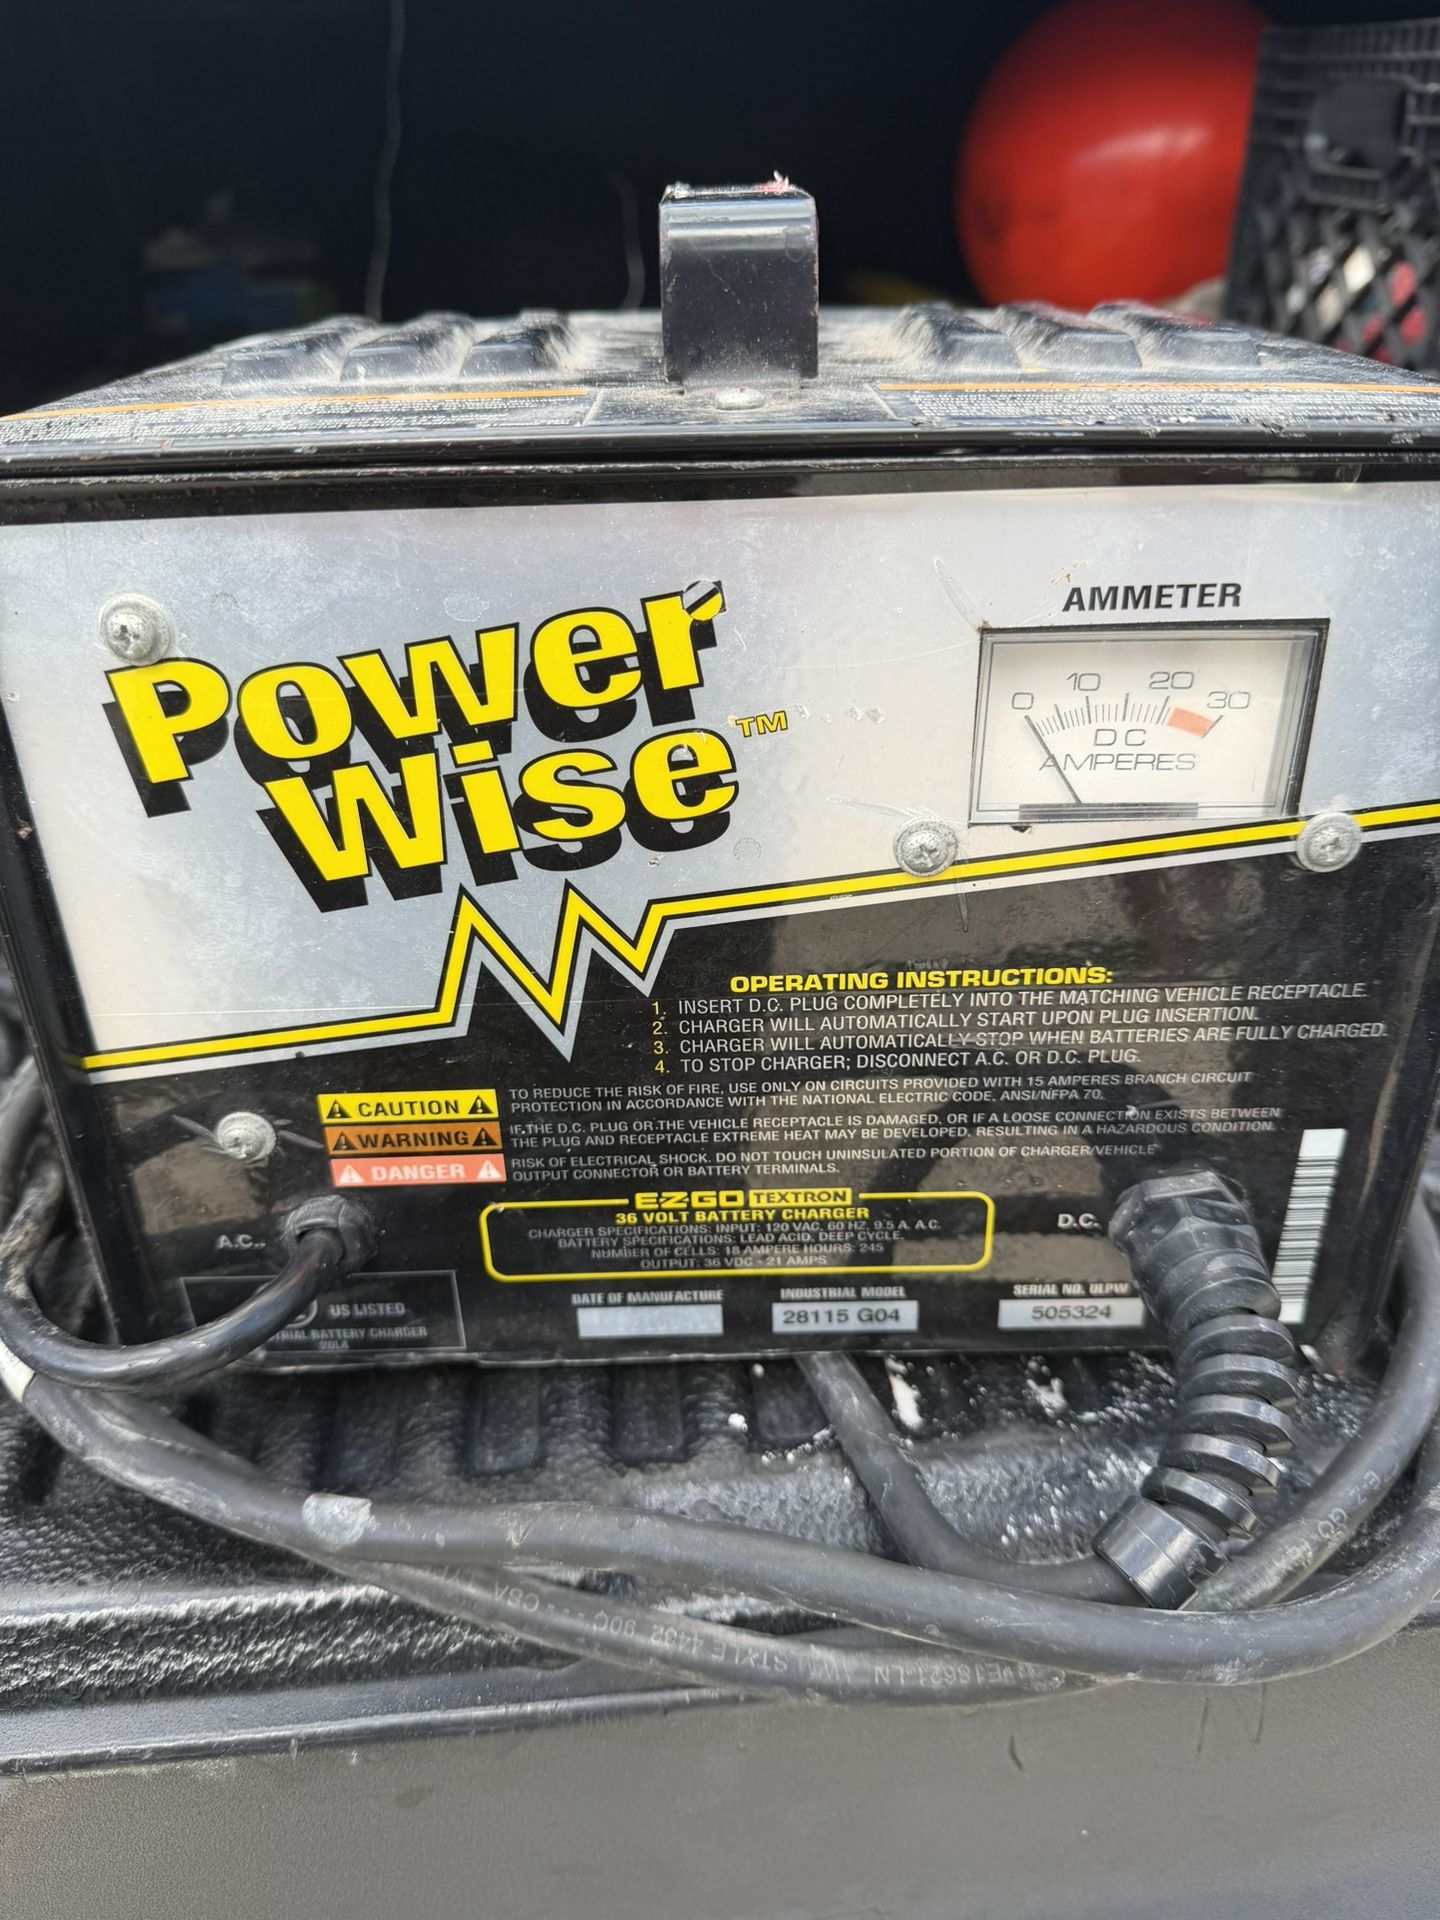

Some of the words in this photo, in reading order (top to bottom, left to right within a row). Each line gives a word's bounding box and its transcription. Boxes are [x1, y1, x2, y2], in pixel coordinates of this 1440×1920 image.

[1062, 582, 1242, 612] AMMETER
[1066, 672, 1101, 691] 10
[1149, 671, 1195, 690] 20
[102, 581, 726, 814] Power
[1011, 692, 1035, 710] 0
[1206, 691, 1252, 709] 30
[735, 711, 788, 738] TM
[1039, 753, 1198, 771] AMPERES
[255, 728, 739, 908] Wise
[730, 972, 888, 993] OPERATING
[897, 967, 1113, 988] INSTRUCTIONS:
[652, 1001, 667, 1015] 1.
[678, 999, 743, 1015] INSERT
[749, 998, 783, 1012] D.C.
[790, 996, 838, 1011] PLUG
[844, 993, 965, 1010] COMPLETELY
[970, 991, 1013, 1007] INTO
[1019, 990, 1054, 1006] THE
[1060, 988, 1159, 1004] MATCHING
[1165, 986, 1243, 1002] VEHICLE
[1247, 983, 1368, 1000] RECEPTACLE.
[652, 1021, 667, 1036] 2.
[678, 1018, 764, 1034] CHARGER
[770, 1017, 815, 1031] WILL
[820, 1013, 972, 1030] AUTOMATICALLY
[977, 1011, 1037, 1027] START
[1042, 1010, 1093, 1025] UPON
[1099, 1009, 1149, 1024] PLUG
[1155, 1006, 1259, 1022] INSERTION.
[653, 1040, 669, 1055] 3.
[680, 1038, 764, 1054] CHARGER
[770, 1036, 815, 1051] WILL
[820, 1033, 972, 1050] AUTOMATICALLY
[976, 1031, 1024, 1046] STOP
[1029, 1030, 1083, 1045] WHEN
[1090, 1028, 1188, 1044] BATTERIES
[1193, 1027, 1233, 1042] ARE
[1235, 1025, 1293, 1041] FULLY
[1297, 1022, 1388, 1039] CHARGED.
[654, 1059, 670, 1074] 4.
[680, 1059, 704, 1073] TO
[709, 1057, 755, 1072] STOP
[761, 1055, 851, 1071] CHARGER;
[856, 1052, 971, 1068] DISCONNECT
[975, 1051, 1009, 1066] A.C.
[1015, 1051, 1041, 1065] OR
[1047, 1049, 1081, 1064] D.C.
[1088, 1048, 1141, 1064] PLUG.
[533, 1087, 591, 1099] REDUCE
[595, 1086, 623, 1097] THE
[627, 1085, 662, 1096] RISK
[729, 1083, 757, 1094] USE
[761, 1081, 800, 1093] ONLY
[830, 1079, 898, 1091] CIRCUITS
[904, 1077, 978, 1089] PROVIDED
[983, 1076, 1021, 1087] WITH
[1047, 1074, 1120, 1086] AMPERES
[1124, 1073, 1186, 1084] BRANCH
[1191, 1071, 1252, 1083] CIRCUIT
[357, 1099, 460, 1118] CAUTION
[511, 1101, 602, 1113] PROTECTION
[626, 1097, 724, 1110] ACCORDANCE
[728, 1095, 766, 1107] WITH
[770, 1094, 798, 1106] THE
[802, 1093, 875, 1105] NATIONAL
[879, 1091, 948, 1103] ELECTRIC
[1000, 1089, 1079, 1101] ANSI/NFPA
[526, 1124, 553, 1134] THE
[557, 1123, 586, 1134] D.C.
[590, 1122, 628, 1133] PLUG
[658, 1120, 685, 1131] THE
[689, 1118, 748, 1130] VEHICLE
[753, 1116, 843, 1128] RECEPTACLE
[1003, 1111, 1051, 1123] LOOSE
[1055, 1109, 1150, 1122] CONNECTION
[1155, 1108, 1206, 1120] EXISTS
[1210, 1107, 1280, 1119] BETWEEN
[356, 1130, 469, 1149] WARNING
[510, 1137, 538, 1148] THE
[542, 1136, 581, 1147] PLUG
[585, 1135, 615, 1146] AND
[620, 1132, 709, 1145] RECEPTACLE
[714, 1131, 779, 1142] EXTREME
[784, 1130, 820, 1140] HEAT
[825, 1129, 857, 1140] MAY
[976, 1125, 1058, 1136] RESULTING
[1082, 1124, 1092, 1135] A
[1096, 1122, 1187, 1135] HAZARDOUS
[1191, 1121, 1275, 1133] CONDITION.
[511, 1157, 545, 1169] RISK
[549, 1157, 567, 1168] OF
[571, 1154, 656, 1167] ELECTRICAL
[659, 1153, 711, 1165] SHOCK.
[716, 1152, 736, 1163] DO
[740, 1151, 770, 1162] NOT
[774, 1150, 822, 1161] TOUCH
[826, 1148, 926, 1160] UNINSULATED
[930, 1147, 994, 1159] PORTION
[999, 1146, 1018, 1157] OF
[1021, 1144, 1156, 1157] CHARGER/VEHICLE
[370, 1163, 465, 1182] DANGER
[513, 1169, 569, 1182] OUTPUT
[573, 1167, 659, 1180] CONNECTOR
[663, 1166, 683, 1177] OR
[688, 1164, 750, 1176] BATTERY
[755, 1162, 840, 1175] TERMINALS.
[635, 1190, 744, 1210] EZGO
[753, 1190, 848, 1204] TEXTRON
[616, 1213, 637, 1224] 36
[642, 1211, 690, 1224] VOLT
[695, 1209, 777, 1223] BATTERY
[781, 1207, 870, 1221] CHARGER
[1057, 1213, 1099, 1228] D.C.
[528, 1228, 594, 1240] CHARGER
[598, 1224, 711, 1237] SPECIFICATIONS:
[716, 1223, 761, 1234] INPUT:
[765, 1222, 788, 1232] 120
[827, 1221, 845, 1231] 60
[558, 1238, 619, 1249] BATTERY
[623, 1234, 736, 1247] SPECIFICATIONS:
[740, 1233, 775, 1244] LEAD
[818, 1231, 854, 1242] DEEP
[591, 1248, 650, 1260] NUMBER
[724, 1244, 740, 1255] 18
[743, 1243, 800, 1255] AMPERE
[859, 1242, 884, 1253] 245
[640, 1258, 700, 1269] OUTPUT:
[704, 1257, 721, 1267] 36
[724, 1256, 753, 1267] VDC
[786, 1255, 828, 1266] AMPS
[571, 1292, 605, 1305] DATE
[627, 1289, 724, 1304] MANUFACTURE
[780, 1287, 857, 1299] INDUSTRIAL
[860, 1286, 906, 1298] MODEL
[1013, 1283, 1058, 1297] SERIAL
[1062, 1283, 1085, 1295] NO.
[330, 1303, 351, 1317] US
[354, 1302, 406, 1317] LISTED
[783, 1309, 849, 1324] 28115
[857, 1308, 901, 1323] G04
[1031, 1305, 1112, 1321] 505324
[311, 1327, 366, 1340] BATTERY
[368, 1325, 428, 1338] CHARGER
[650, 1624, 704, 1655] 4432
[711, 1643, 788, 1671] STYLE
